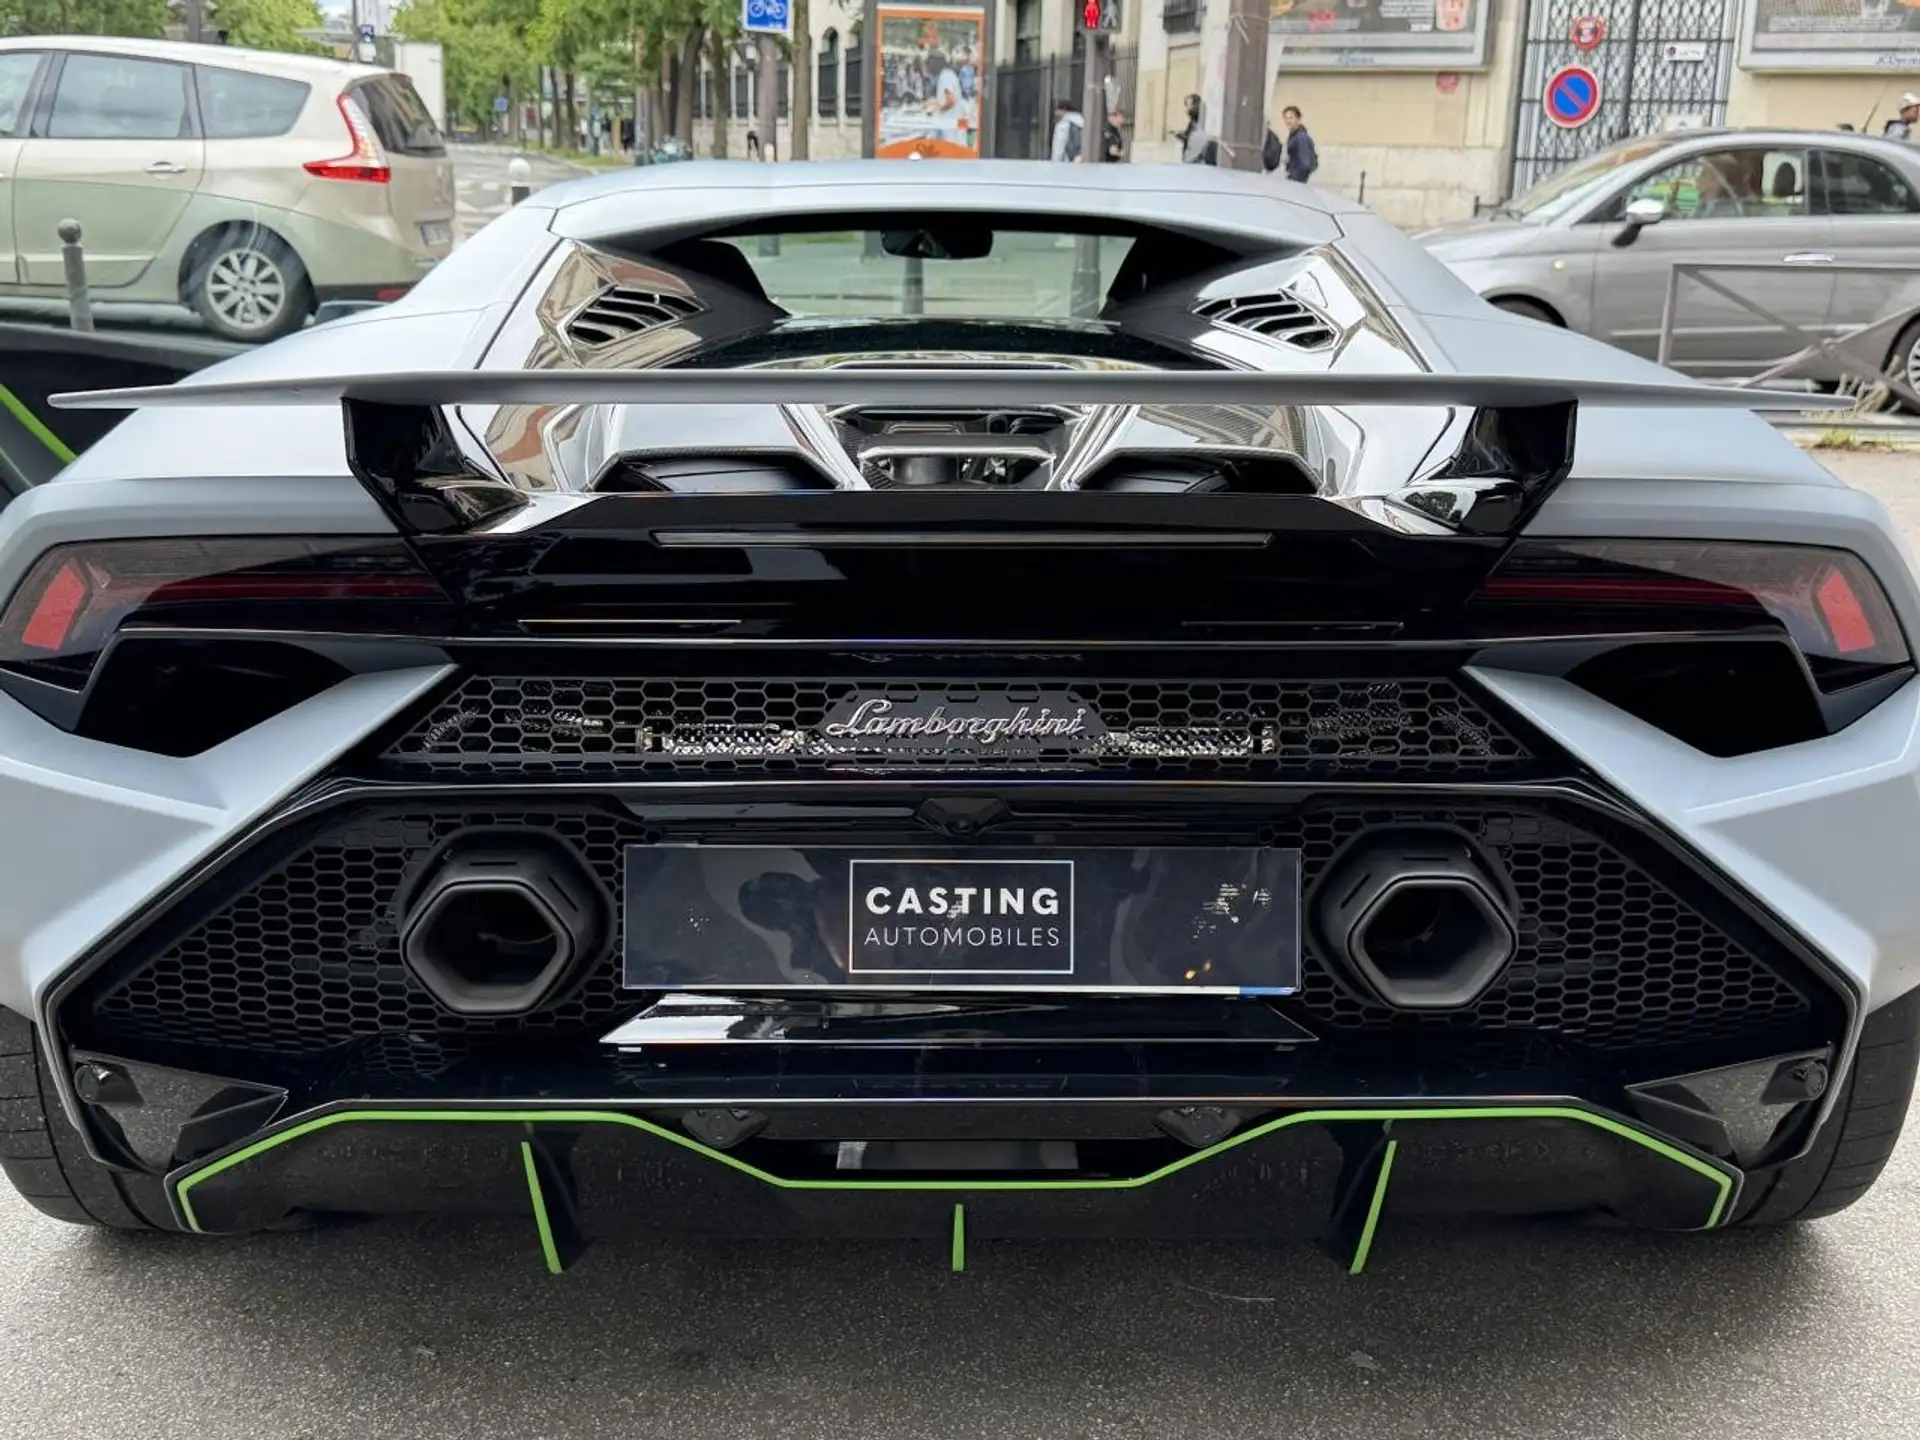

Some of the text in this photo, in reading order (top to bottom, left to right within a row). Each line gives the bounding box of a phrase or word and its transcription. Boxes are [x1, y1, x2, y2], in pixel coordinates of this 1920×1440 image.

[826, 699, 1087, 744] Lamborghini
[865, 886, 1059, 916] CASTING
[863, 926, 1060, 948] AUTOMOBILES
